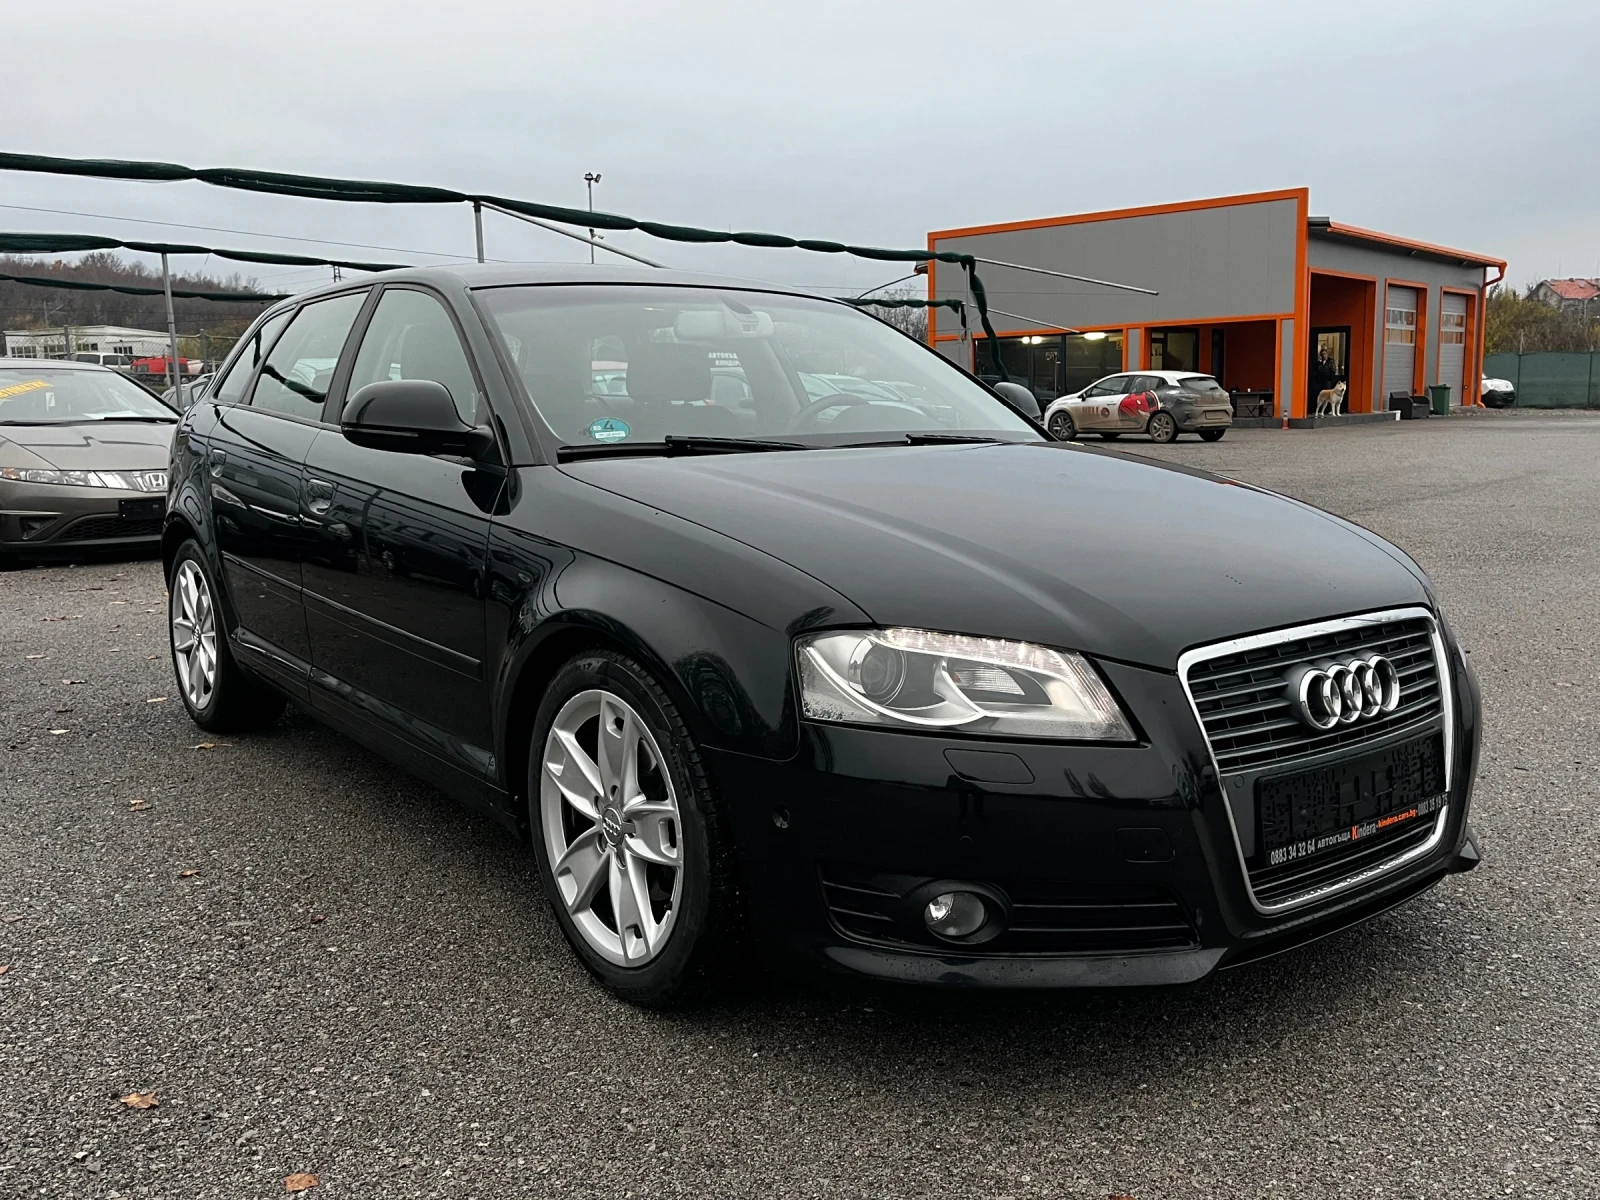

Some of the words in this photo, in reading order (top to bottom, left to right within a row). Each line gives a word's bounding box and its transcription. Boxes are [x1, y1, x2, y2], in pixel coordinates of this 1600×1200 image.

[604, 420, 614, 430] 4
[1270, 847, 1287, 865] 0883
[1288, 844, 1297, 860] 34
[1298, 841, 1307, 857] 32
[1307, 839, 1315, 854] 64
[1317, 831, 1351, 849] АВТОКЪЩА
